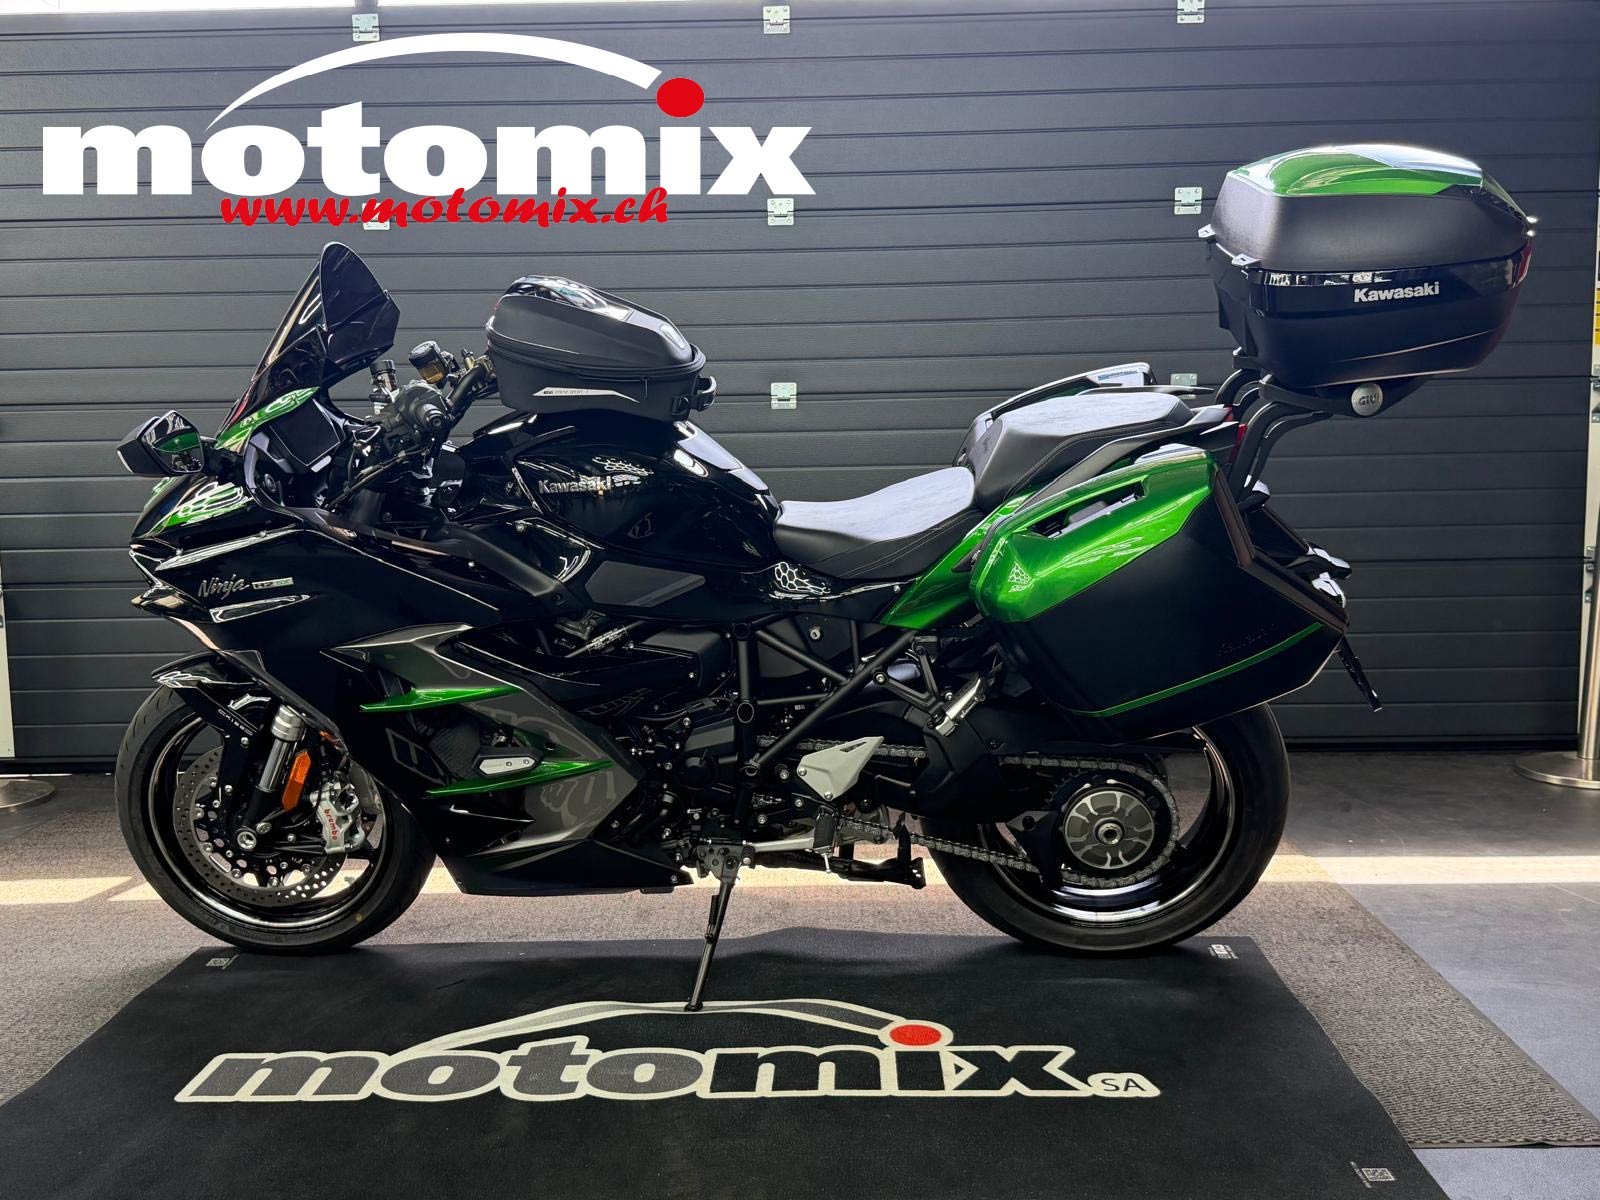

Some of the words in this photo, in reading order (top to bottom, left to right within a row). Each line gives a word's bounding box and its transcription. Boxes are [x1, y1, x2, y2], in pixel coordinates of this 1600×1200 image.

[1353, 281, 1440, 303] Kawasaki
[538, 475, 612, 494] Kawasaki
[197, 573, 250, 601] Ninja
[323, 808, 338, 841] brembo
[180, 1021, 1088, 1101] motomix
[1099, 1076, 1146, 1093] SA
